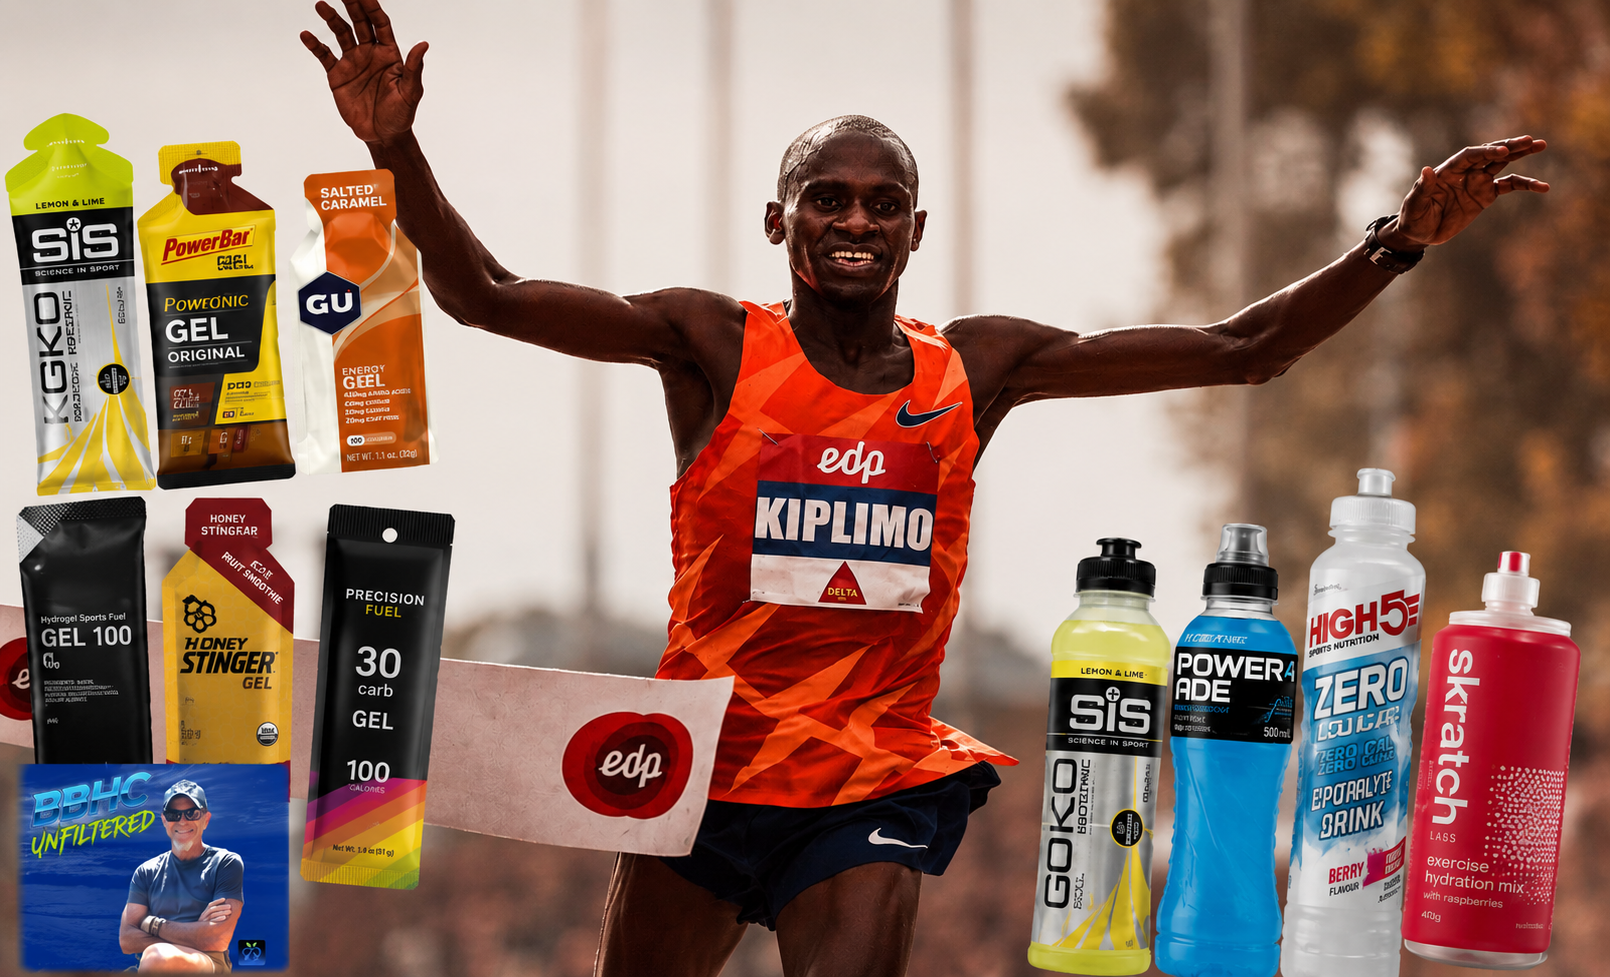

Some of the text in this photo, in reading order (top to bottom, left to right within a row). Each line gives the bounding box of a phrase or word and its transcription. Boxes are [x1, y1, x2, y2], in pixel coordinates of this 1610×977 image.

[320, 184, 374, 198] SALTED
[35, 197, 105, 210] LEMON & LIME
[320, 195, 387, 211] CARAMEL
[162, 228, 254, 262] PowerBar
[34, 268, 74, 277] SCIENCE
[89, 264, 120, 273] SPORT
[305, 291, 353, 315] GU
[165, 316, 229, 344] GEL
[167, 346, 245, 363] ORIGINAL
[346, 453, 360, 462] NET
[361, 452, 375, 461] WT.
[817, 441, 886, 485] edp
[210, 514, 246, 523] HONEY
[754, 496, 934, 552] KIPLIMO
[346, 588, 425, 606] PRECISION
[827, 587, 858, 598] DELTA
[40, 612, 126, 625] Hydrogel Sports Fuel
[365, 604, 402, 618] FUEL
[41, 625, 132, 647] GEL 100
[184, 637, 248, 650] HONEY
[1333, 633, 1380, 650] NUTRITION
[179, 651, 277, 674] STINGER
[355, 645, 402, 679] 30
[1080, 667, 1112, 676] LEMON
[1124, 670, 1144, 679] LIME
[242, 676, 272, 690] GEL
[358, 683, 394, 698] carb
[1175, 677, 1232, 703] ADE
[1314, 658, 1408, 720] ZERO
[352, 710, 394, 730] GEL
[1068, 737, 1106, 746] SCIENCE
[1122, 740, 1149, 749] SPORT
[1432, 649, 1480, 824] skratch
[346, 759, 391, 783] 100
[598, 743, 662, 788] edp
[1317, 757, 1357, 776] ZERO
[1044, 758, 1078, 909] GOKO
[1328, 861, 1365, 885] BERRY
[1427, 855, 1489, 873] exercise
[1329, 881, 1360, 897] FLAVOUR
[1424, 870, 1525, 894] hydration mix
[1423, 891, 1504, 909] with raspberries
